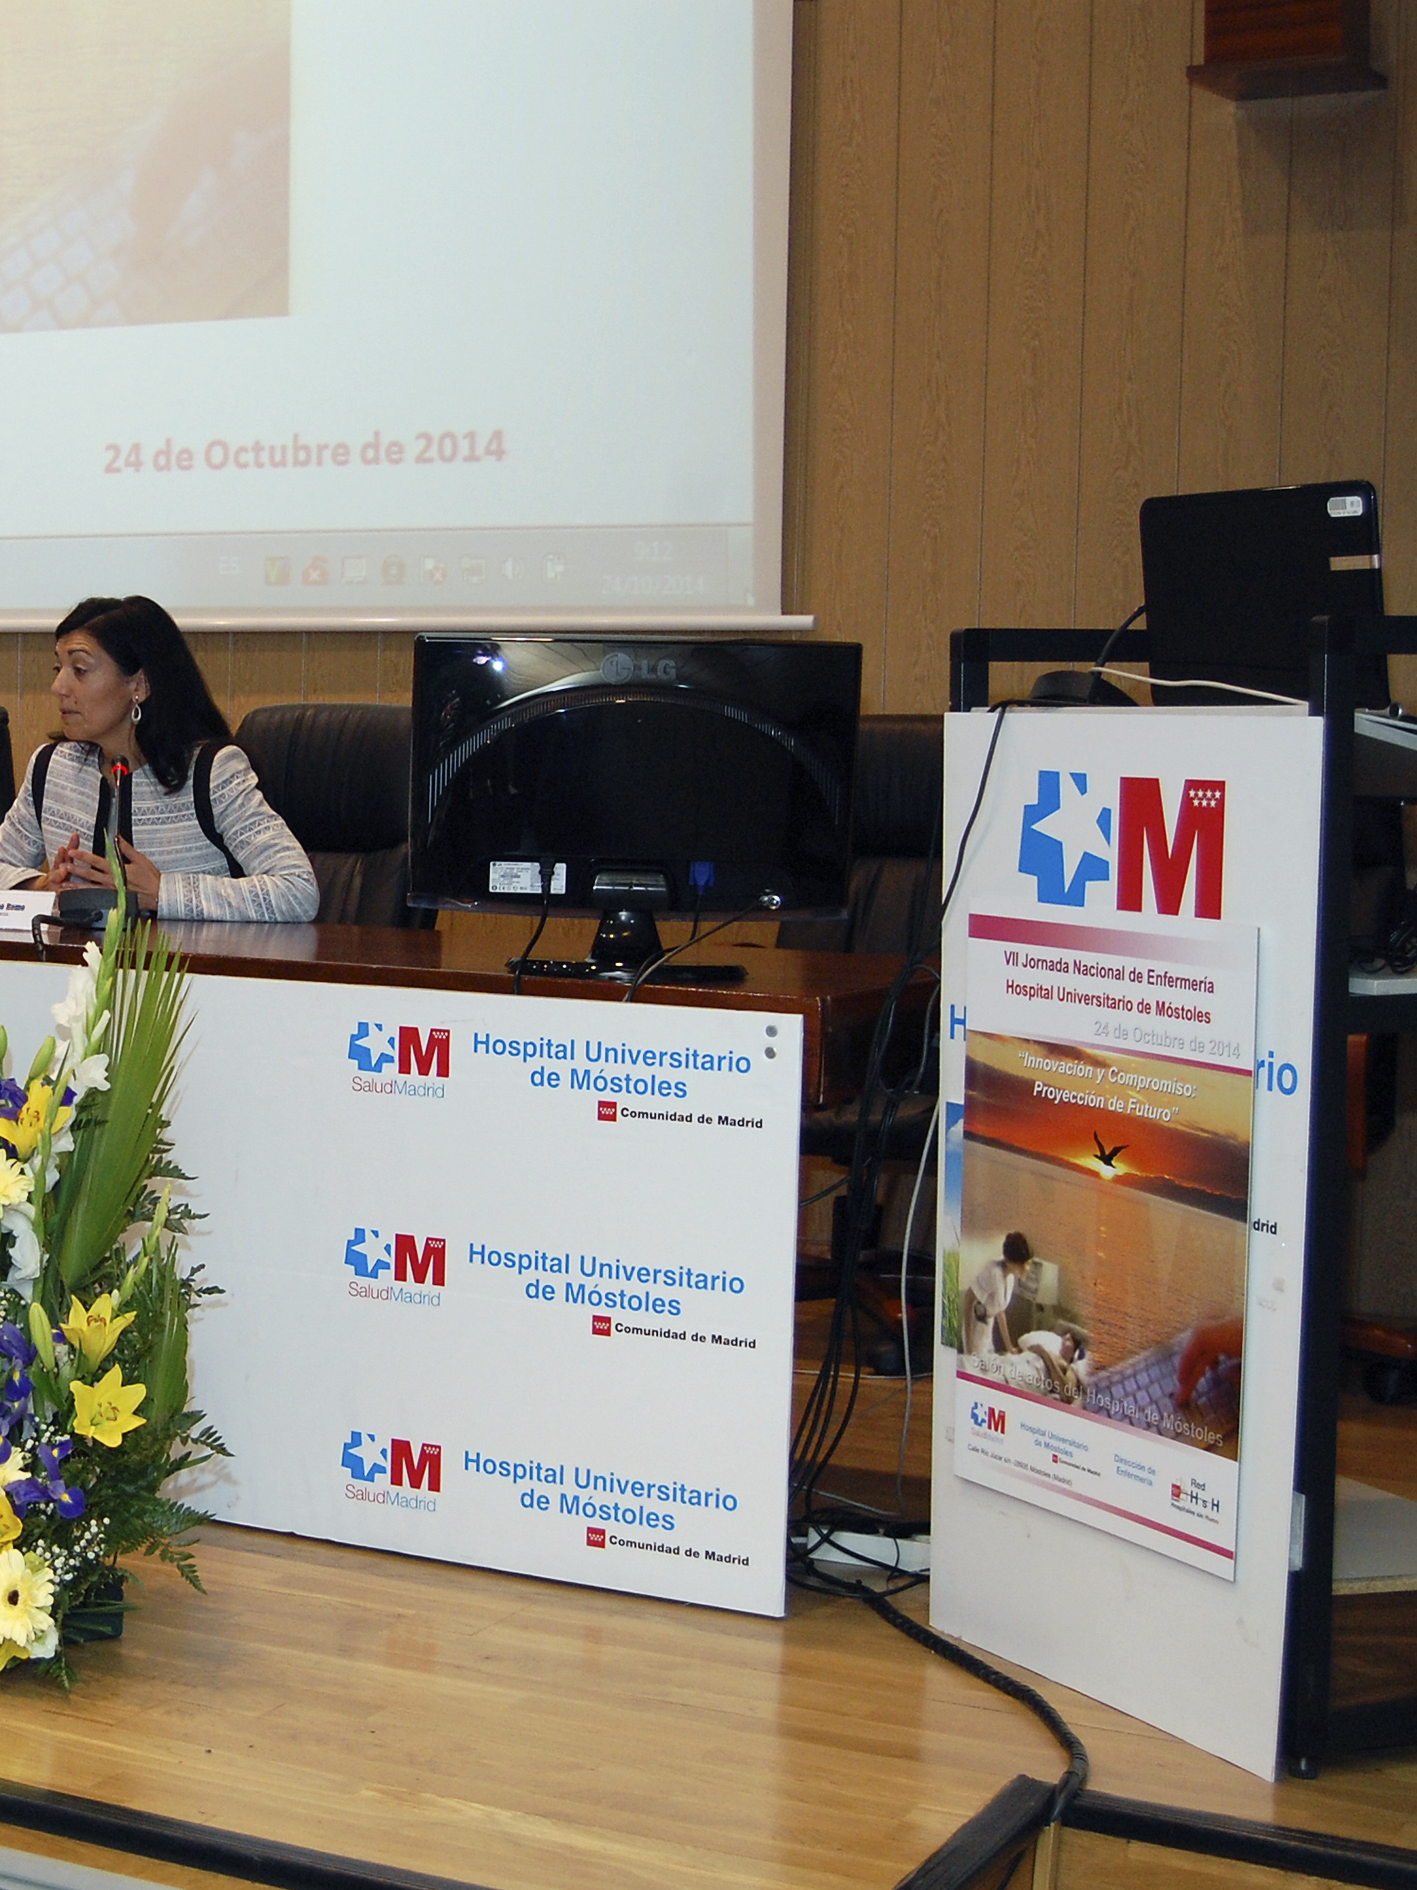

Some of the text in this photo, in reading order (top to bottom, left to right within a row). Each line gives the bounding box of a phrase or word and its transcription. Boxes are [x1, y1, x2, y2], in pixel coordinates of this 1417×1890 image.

[103, 430, 507, 474] 24 de Octubre de 2014
[642, 660, 677, 680] LG
[1003, 950, 1215, 994] VII Jornada Nacional de Enfermería
[1006, 979, 1211, 1025] Hospital Universitario de Móstoles
[473, 1033, 751, 1074] Hospital Universitario
[1094, 1020, 1241, 1060] 24 de Octubre de 2014
[352, 1076, 445, 1099] SaludMadrid
[530, 1066, 688, 1099] de Móstoles
[1033, 1081, 1104, 1110] Proyección
[1108, 1092, 1125, 1112] de
[1108, 1066, 1197, 1098] Compromiso:
[620, 1107, 763, 1129] Comunidad de Madrid
[469, 1243, 745, 1294] Hospital Universitario
[348, 1281, 441, 1307] SaludMadrid
[525, 1279, 682, 1316] de Móstoles
[614, 1322, 756, 1349] Comunidad de Madrid
[1026, 1375, 1060, 1393] actos
[1086, 1387, 1139, 1418] Hospital
[1144, 1409, 1159, 1425] de
[1163, 1412, 1224, 1448] Móstoles
[1114, 1453, 1146, 1472] Dirección
[463, 1450, 738, 1512] Hospital Universitario
[1190, 1478, 1206, 1491] Red
[344, 1483, 437, 1513] SaludMadrid
[520, 1488, 675, 1531] de Móstoles
[609, 1534, 750, 1567] Comunidad de Madrid
